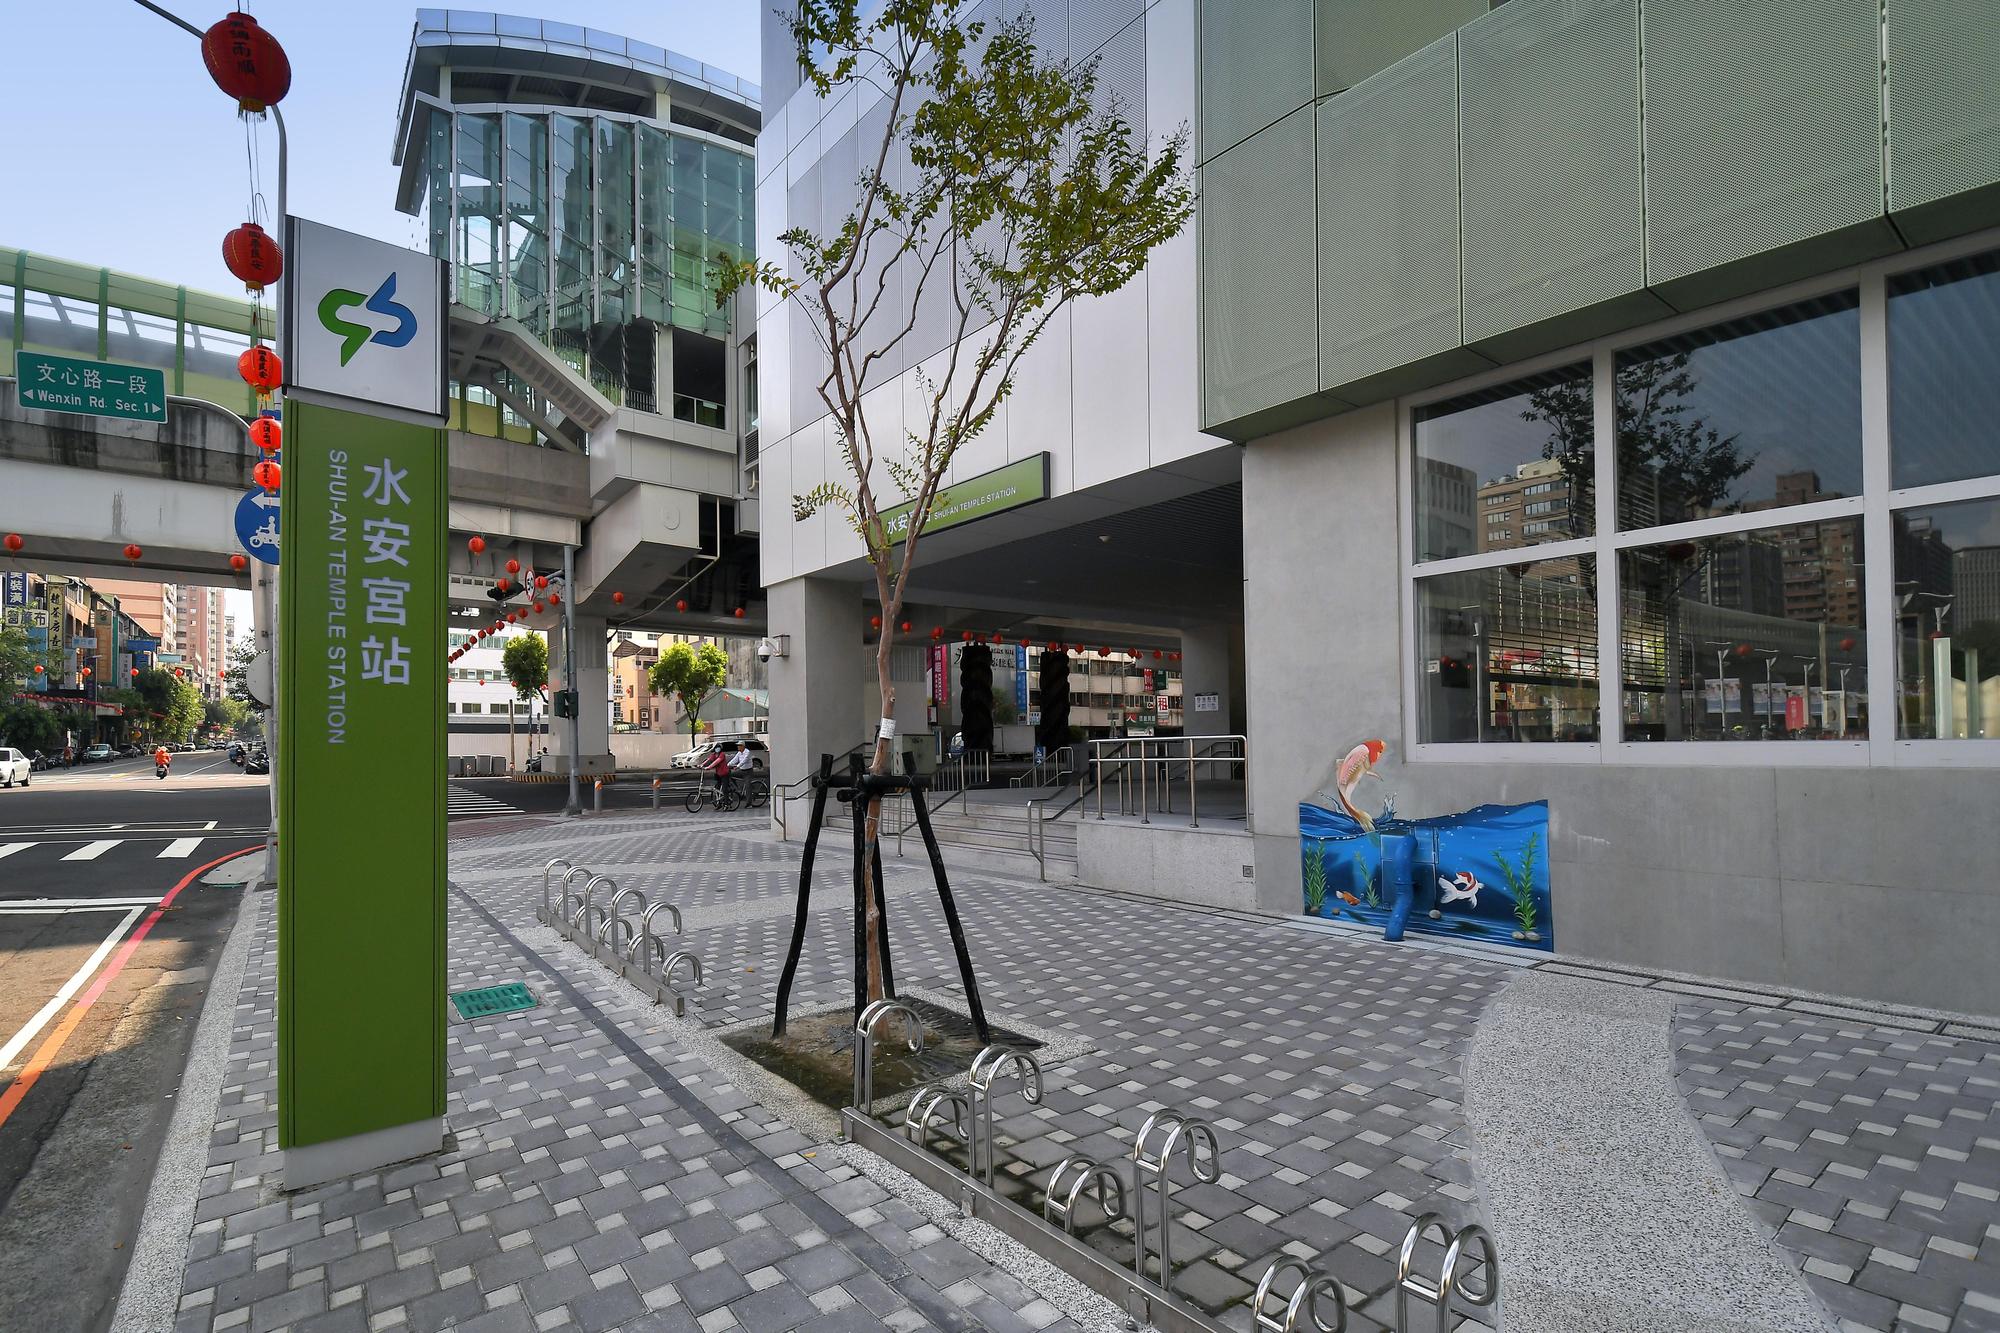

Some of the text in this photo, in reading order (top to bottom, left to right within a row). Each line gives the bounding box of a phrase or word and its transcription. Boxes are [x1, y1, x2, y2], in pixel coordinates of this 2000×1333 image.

[37, 363, 148, 395] 文心路一段
[38, 389, 150, 413] Wenxin Rd. Sec. 1
[934, 485, 1016, 520] SHUI-AN TEMPLE STATION
[887, 507, 931, 535] 水安
[361, 457, 412, 686] 水安宮站
[327, 449, 348, 744] SHUI-AN TEMPLE STATION
[1158, 697, 1168, 711] 租
